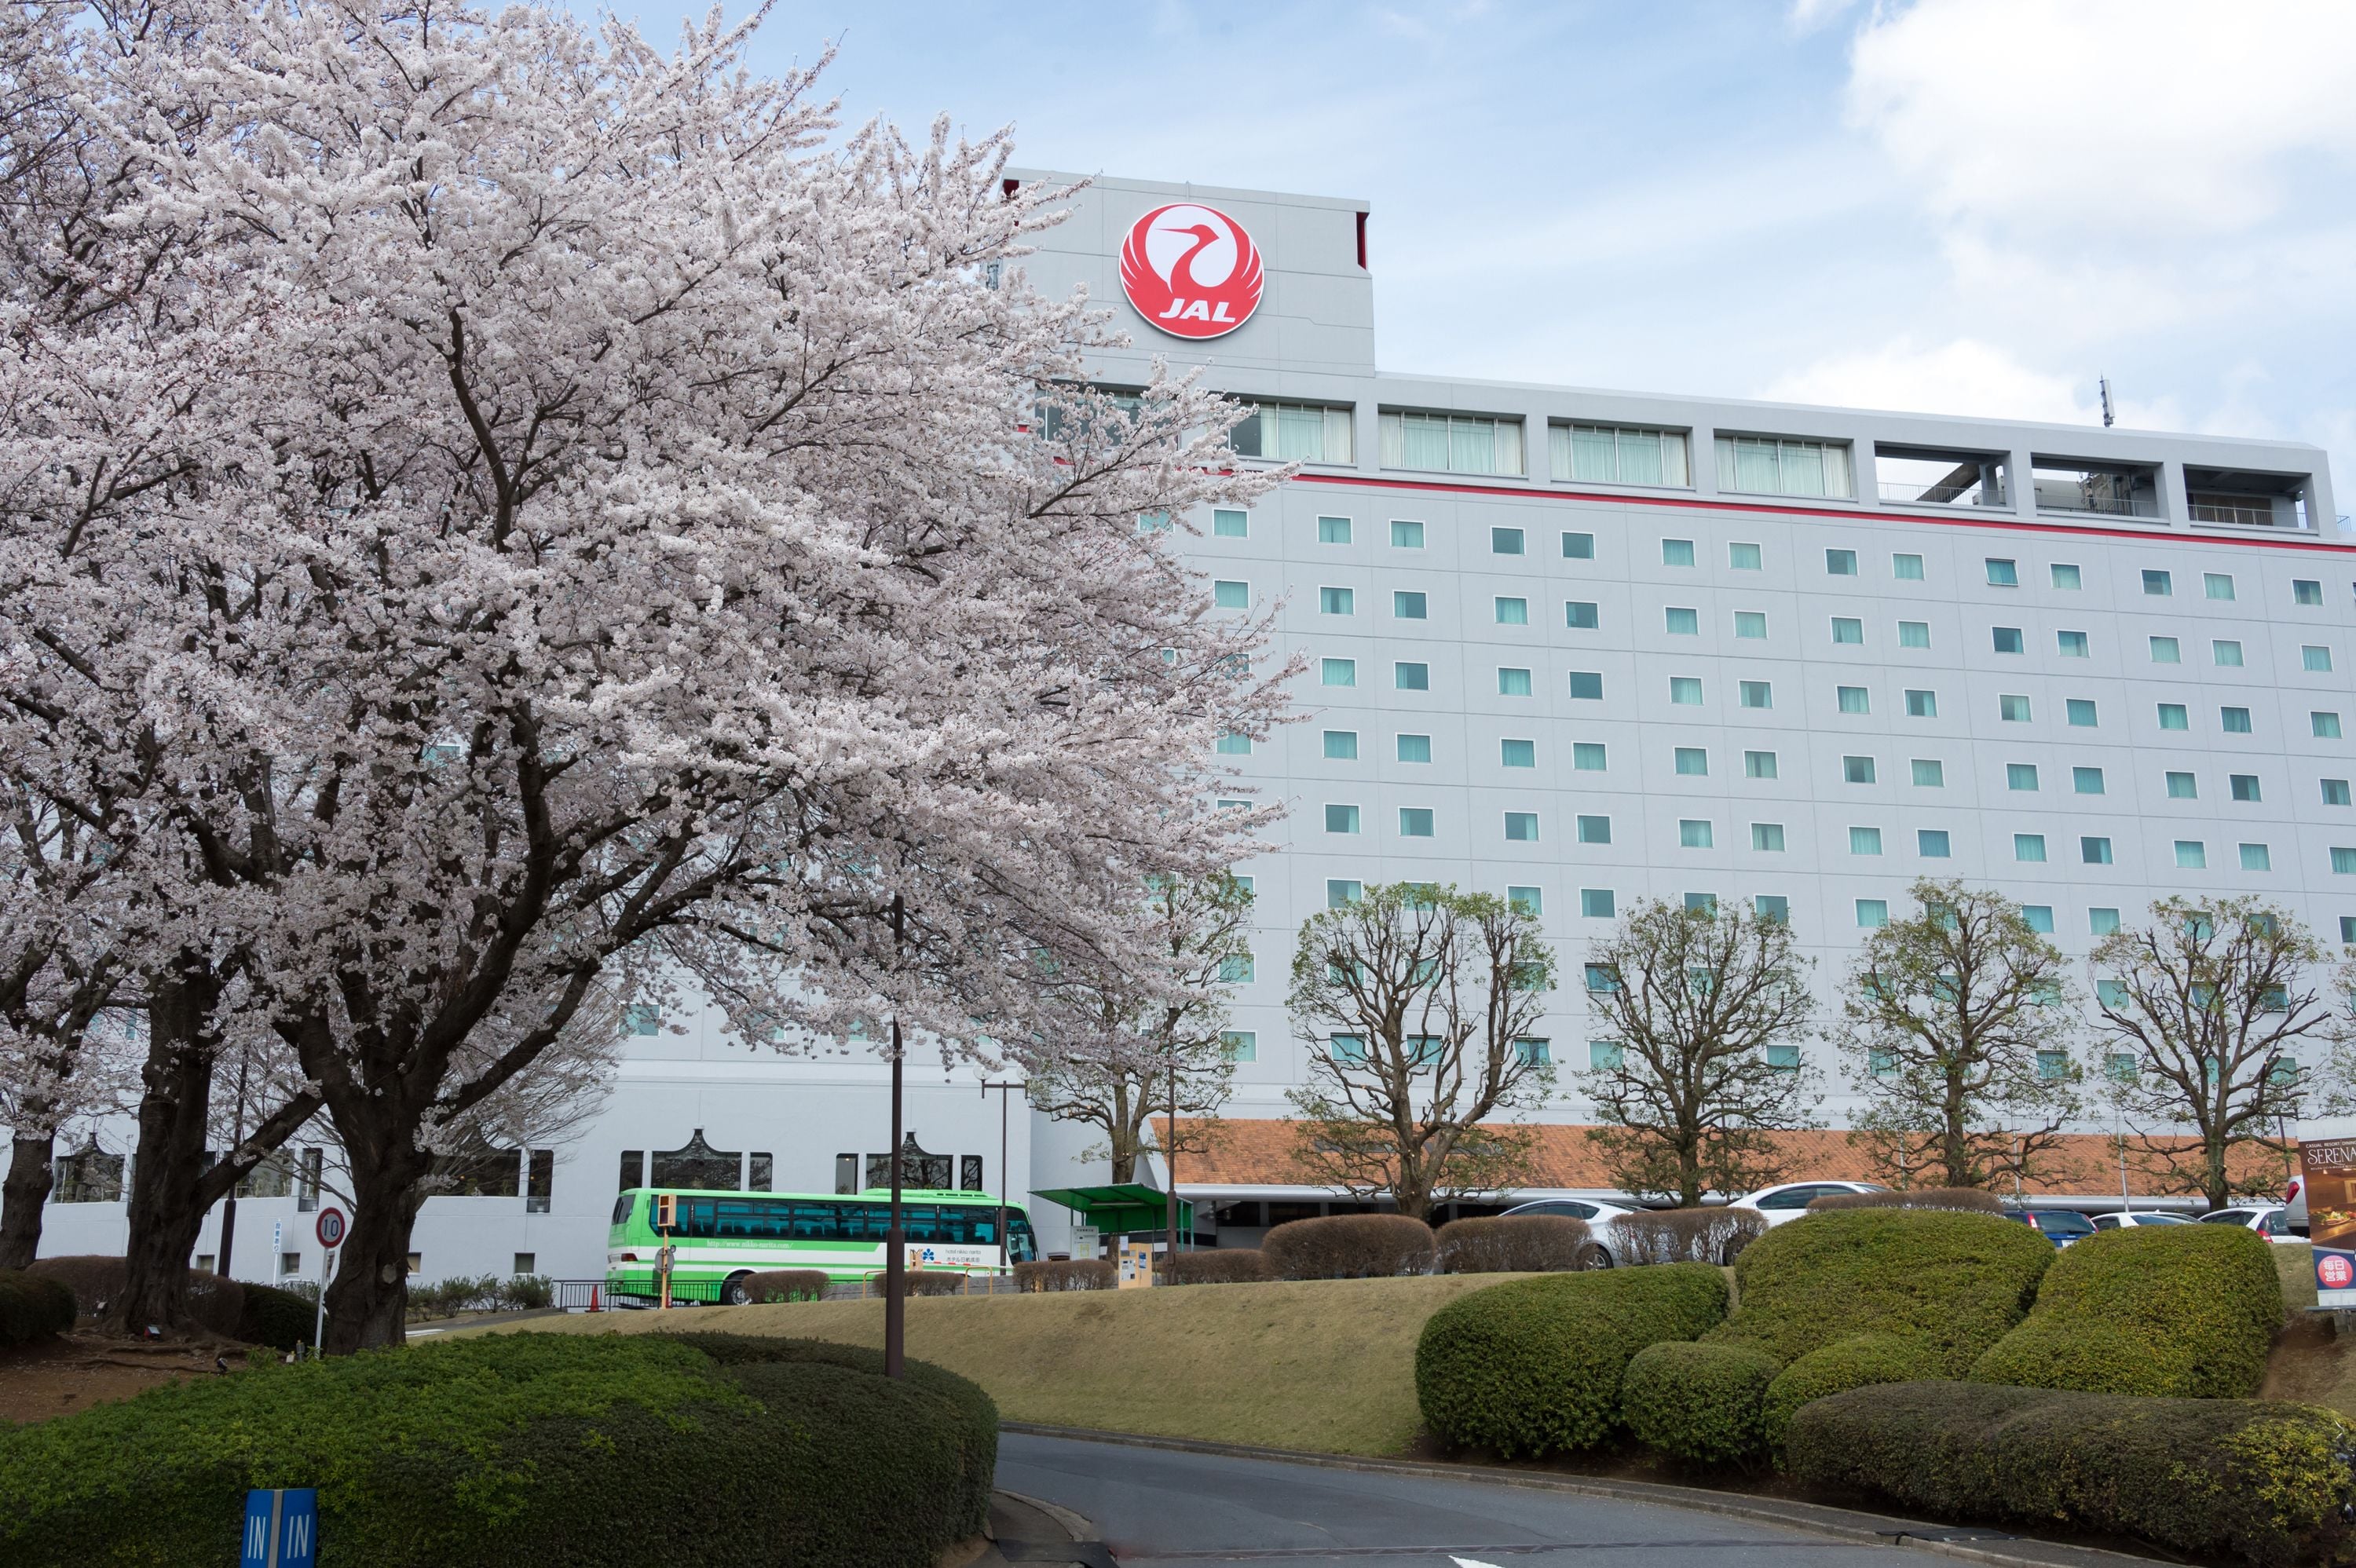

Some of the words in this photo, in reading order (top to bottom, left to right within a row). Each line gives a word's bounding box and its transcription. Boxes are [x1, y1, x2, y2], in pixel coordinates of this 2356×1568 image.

[1158, 298, 1236, 323] JAL
[324, 1219, 339, 1237] 10
[2323, 1259, 2344, 1270] 毎日
[2325, 1270, 2347, 1281] 営業
[247, 1515, 266, 1560] IN
[286, 1514, 310, 1559] IN
